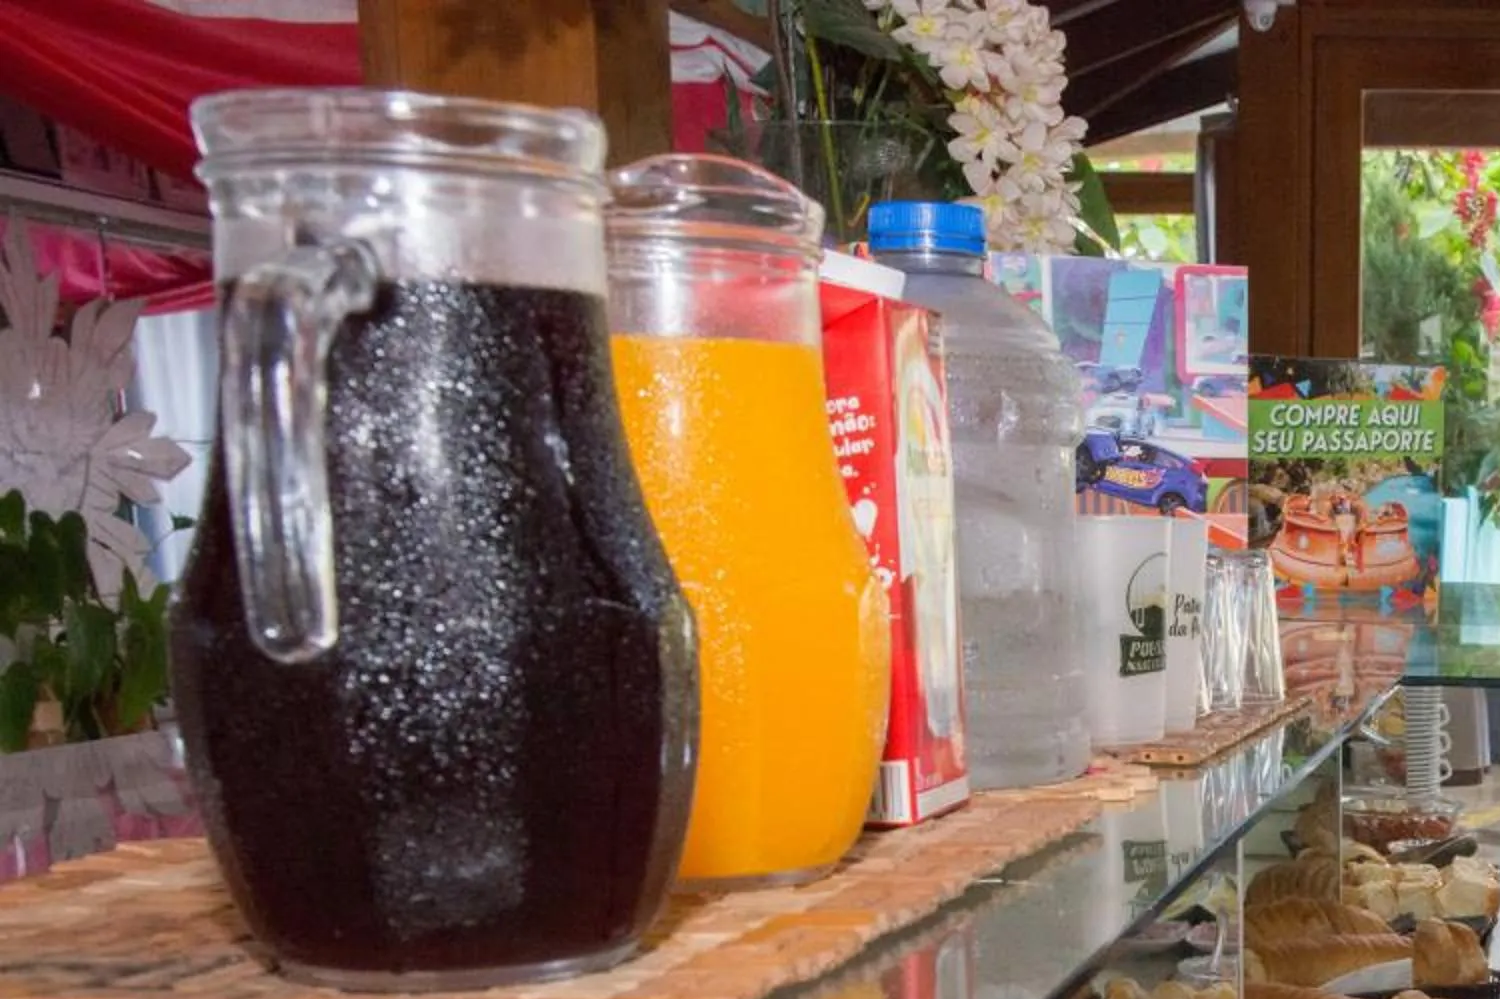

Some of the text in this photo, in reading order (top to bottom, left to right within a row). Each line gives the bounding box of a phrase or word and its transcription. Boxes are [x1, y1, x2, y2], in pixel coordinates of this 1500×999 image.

[1269, 404, 1420, 428] COMPRE AQUI
[1253, 430, 1436, 453] SEU PASSAPORTE
